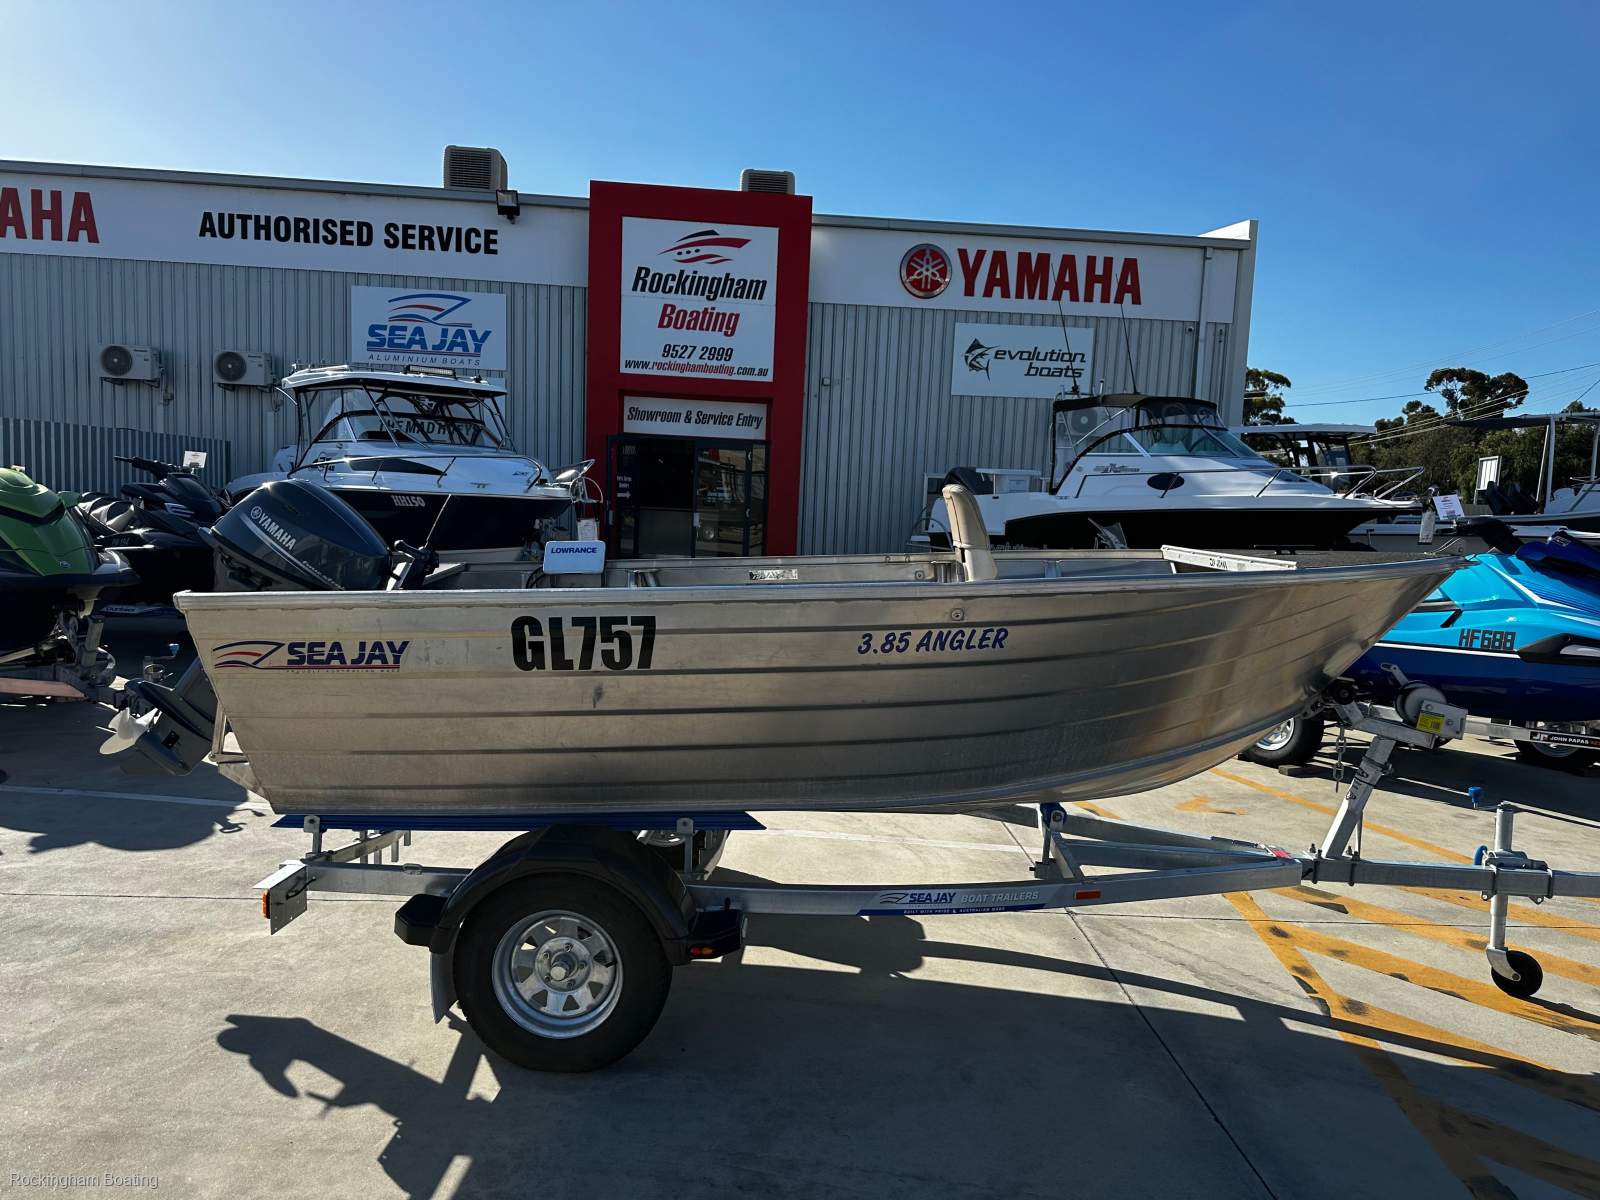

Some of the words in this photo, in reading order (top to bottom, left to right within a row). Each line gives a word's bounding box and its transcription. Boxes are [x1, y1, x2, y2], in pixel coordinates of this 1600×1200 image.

[199, 211, 374, 248] AUTHORISED
[384, 222, 499, 255] SERVICE
[632, 266, 768, 301] Rockingham
[957, 248, 1142, 305] YAMAHA
[657, 303, 741, 337] Boating
[367, 324, 427, 350] SEA
[432, 327, 492, 352] JAY
[368, 354, 438, 364] ALUMINIUM
[442, 357, 481, 366] BOATS
[662, 343, 697, 359] 9527
[699, 346, 734, 361] 2999
[994, 346, 1086, 363] evolution
[624, 359, 768, 377] www.rockinghamboating.com.au
[1024, 363, 1085, 379] boats
[627, 406, 682, 423] Showroom
[684, 410, 693, 424] &
[695, 410, 734, 426] Service
[736, 412, 763, 429] Entry
[259, 513, 297, 550] YAMAHA
[550, 546, 598, 555] LOWRANCE
[511, 615, 656, 671] GL757
[857, 631, 912, 655] 3.85
[915, 627, 1009, 653] ANGLER
[1458, 628, 1517, 650] HF688
[287, 641, 347, 666] SEA
[351, 640, 410, 665] JAY
[1568, 737, 1590, 745] PAPAS
[909, 893, 933, 904] SEA
[933, 892, 956, 904] JAY
[962, 893, 988, 904] BOAT
[991, 891, 1039, 902] TRAILERS
